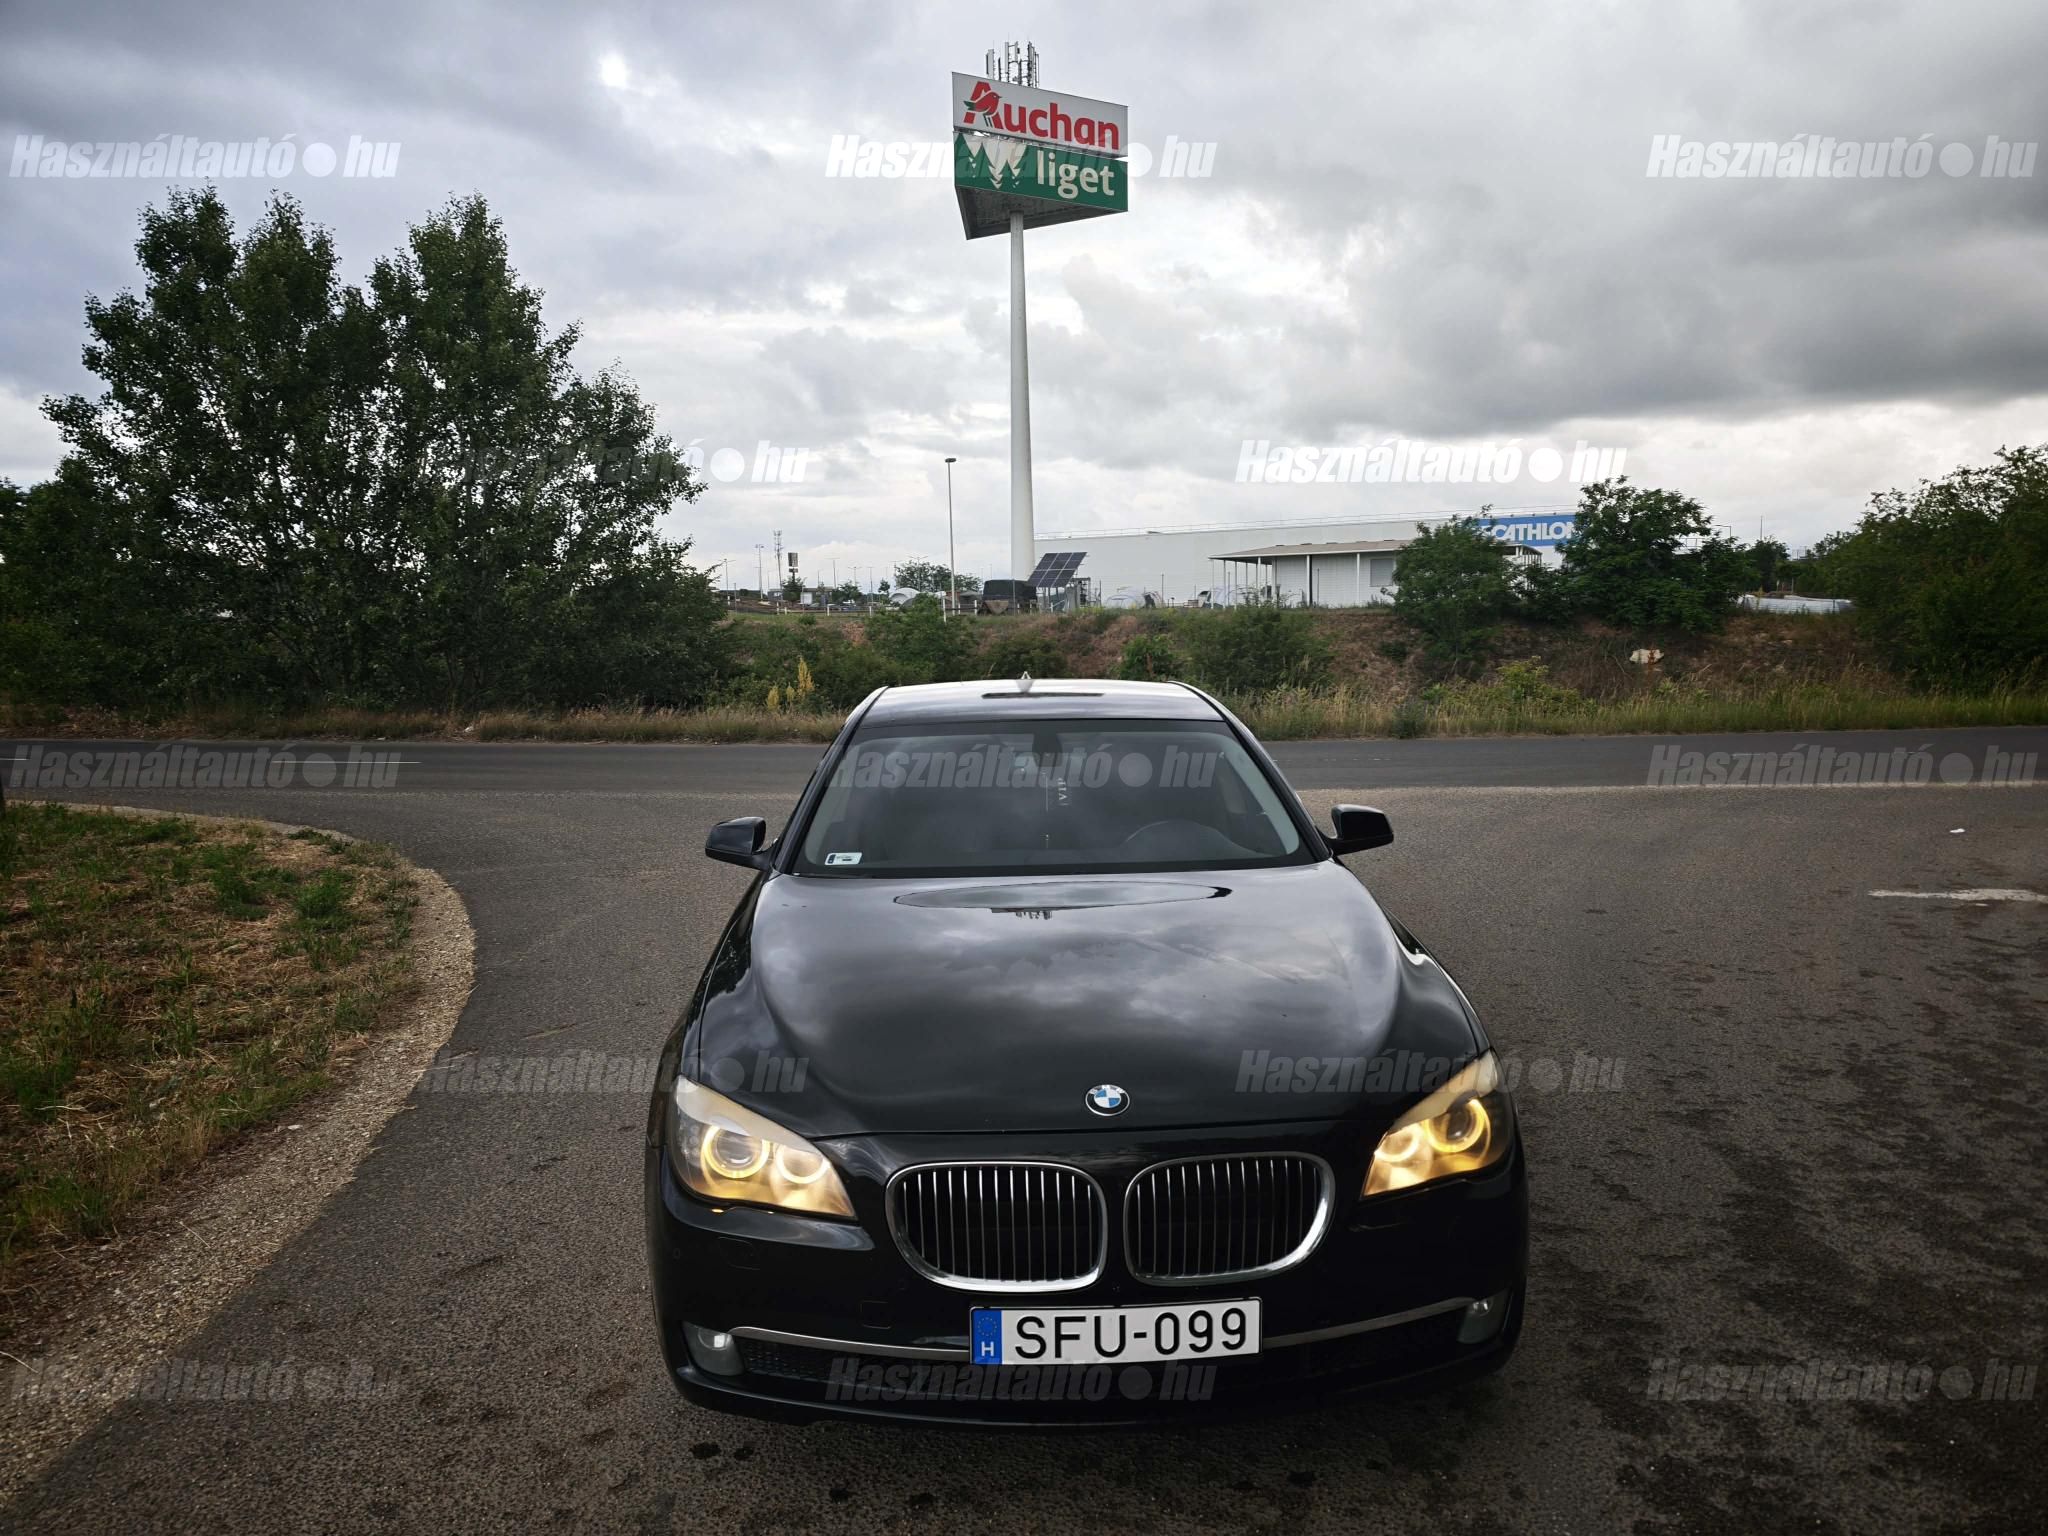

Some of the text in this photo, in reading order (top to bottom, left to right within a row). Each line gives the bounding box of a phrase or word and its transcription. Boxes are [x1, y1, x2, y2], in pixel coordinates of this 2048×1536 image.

[963, 81, 1120, 150] Auchan
[1037, 150, 1115, 199] liget
[981, 1308, 1247, 1359] H SFU-099
